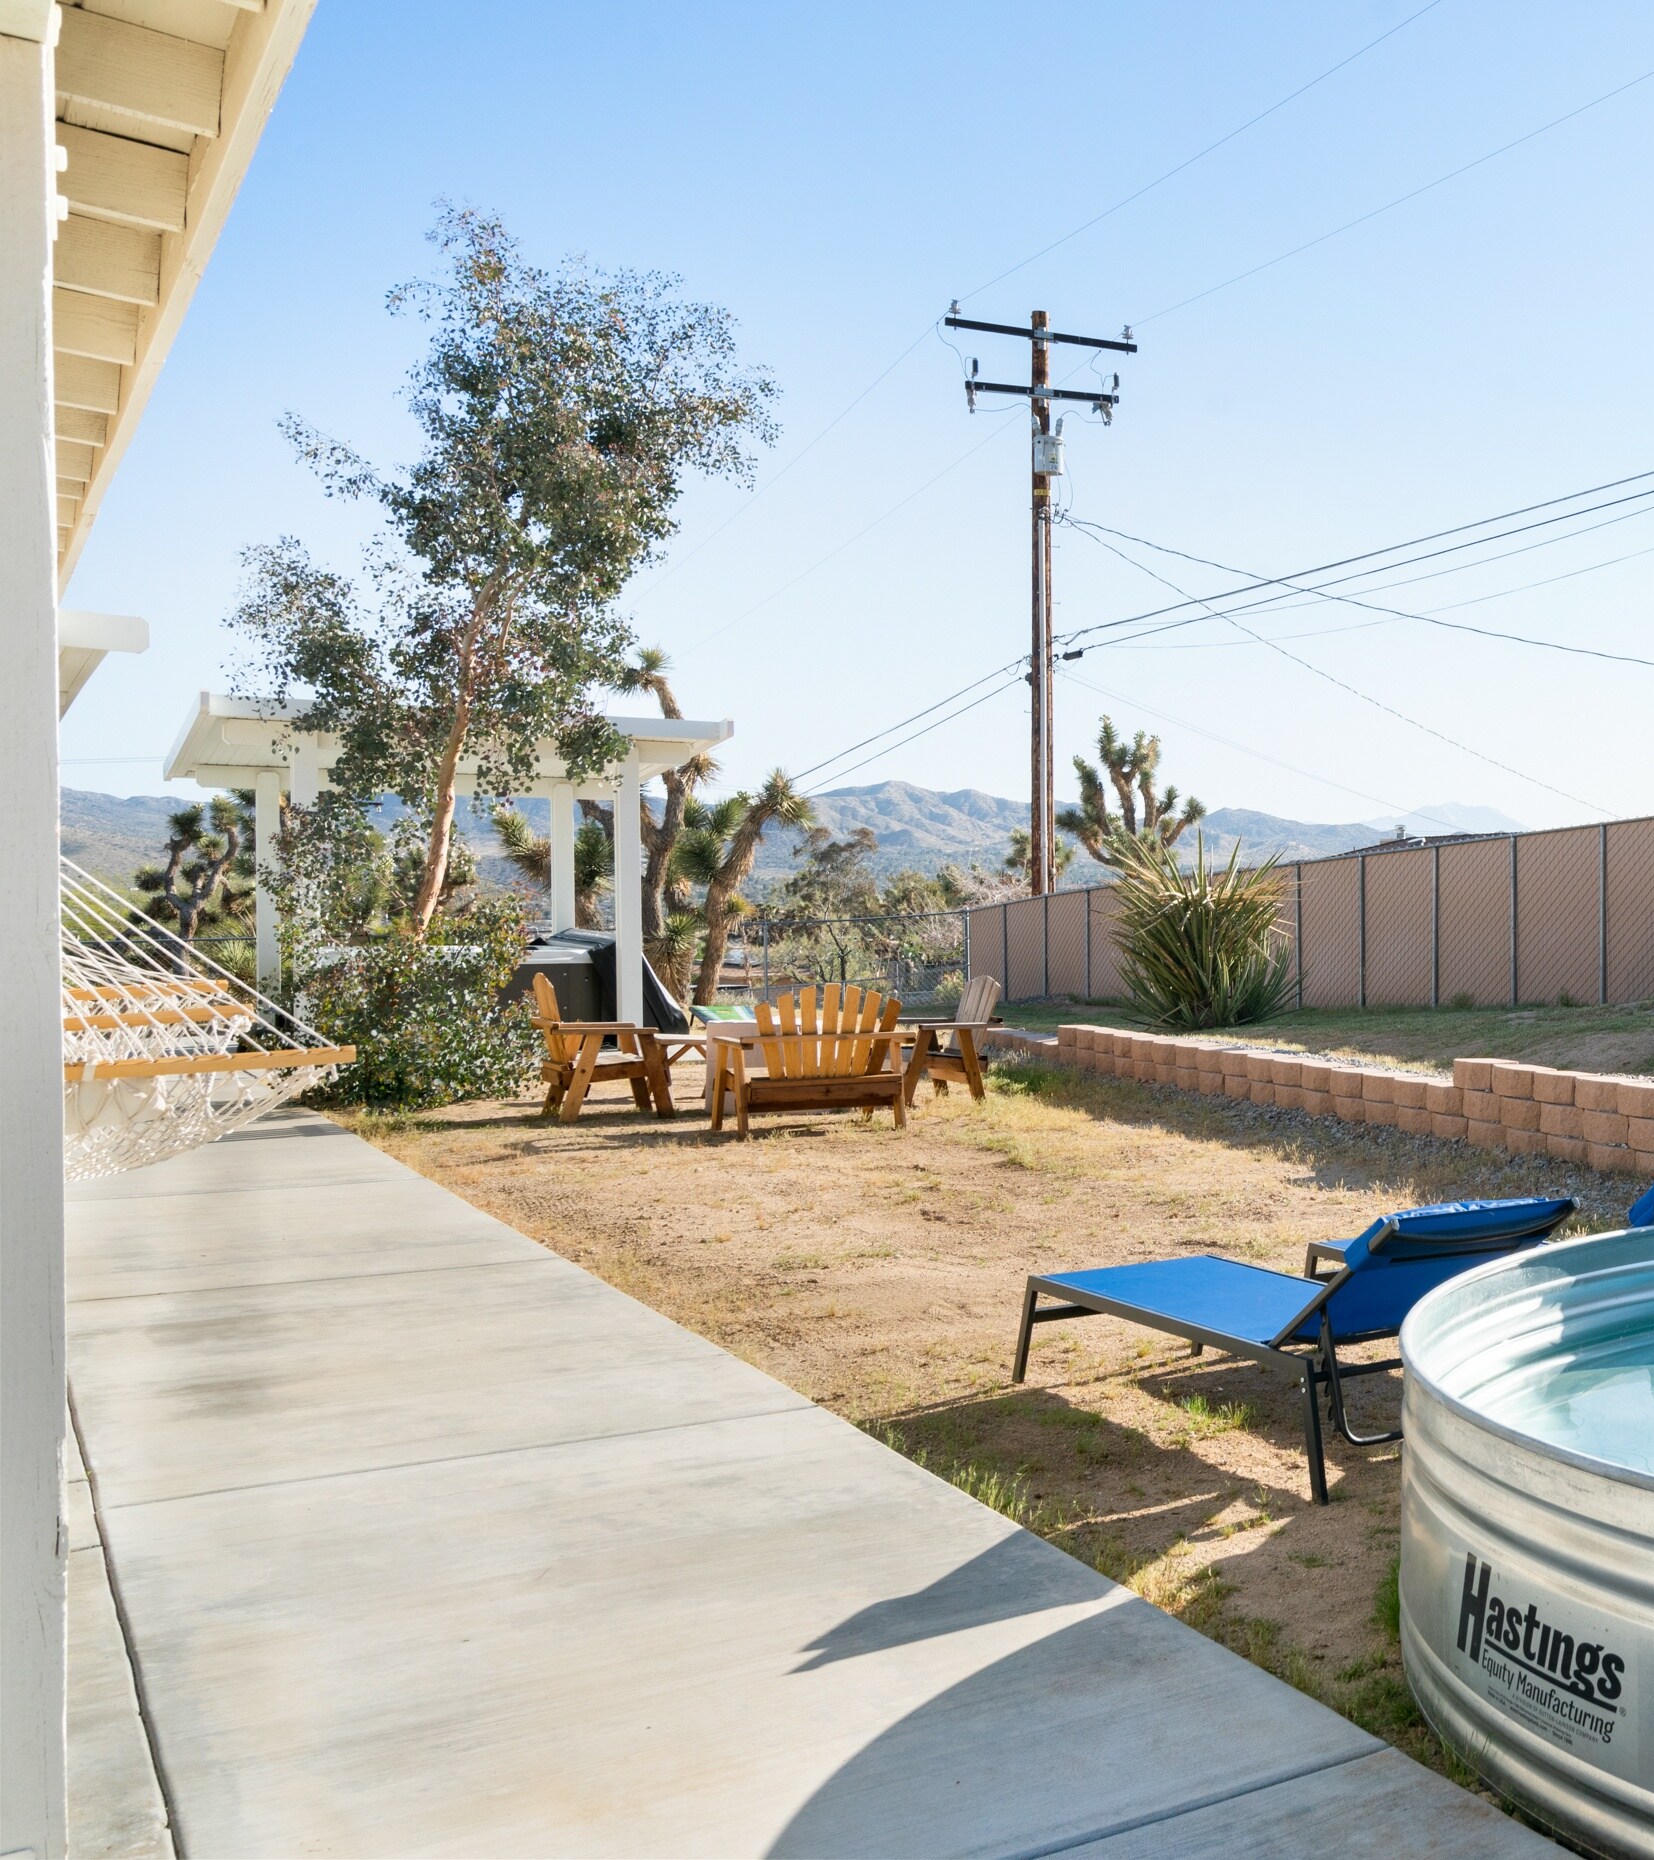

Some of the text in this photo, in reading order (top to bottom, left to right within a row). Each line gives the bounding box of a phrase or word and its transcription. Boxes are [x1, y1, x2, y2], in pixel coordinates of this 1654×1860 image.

[1457, 1551, 1625, 1700] Hastings
[1481, 1648, 1515, 1690] Equity
[1516, 1670, 1615, 1744] Manufacturing
